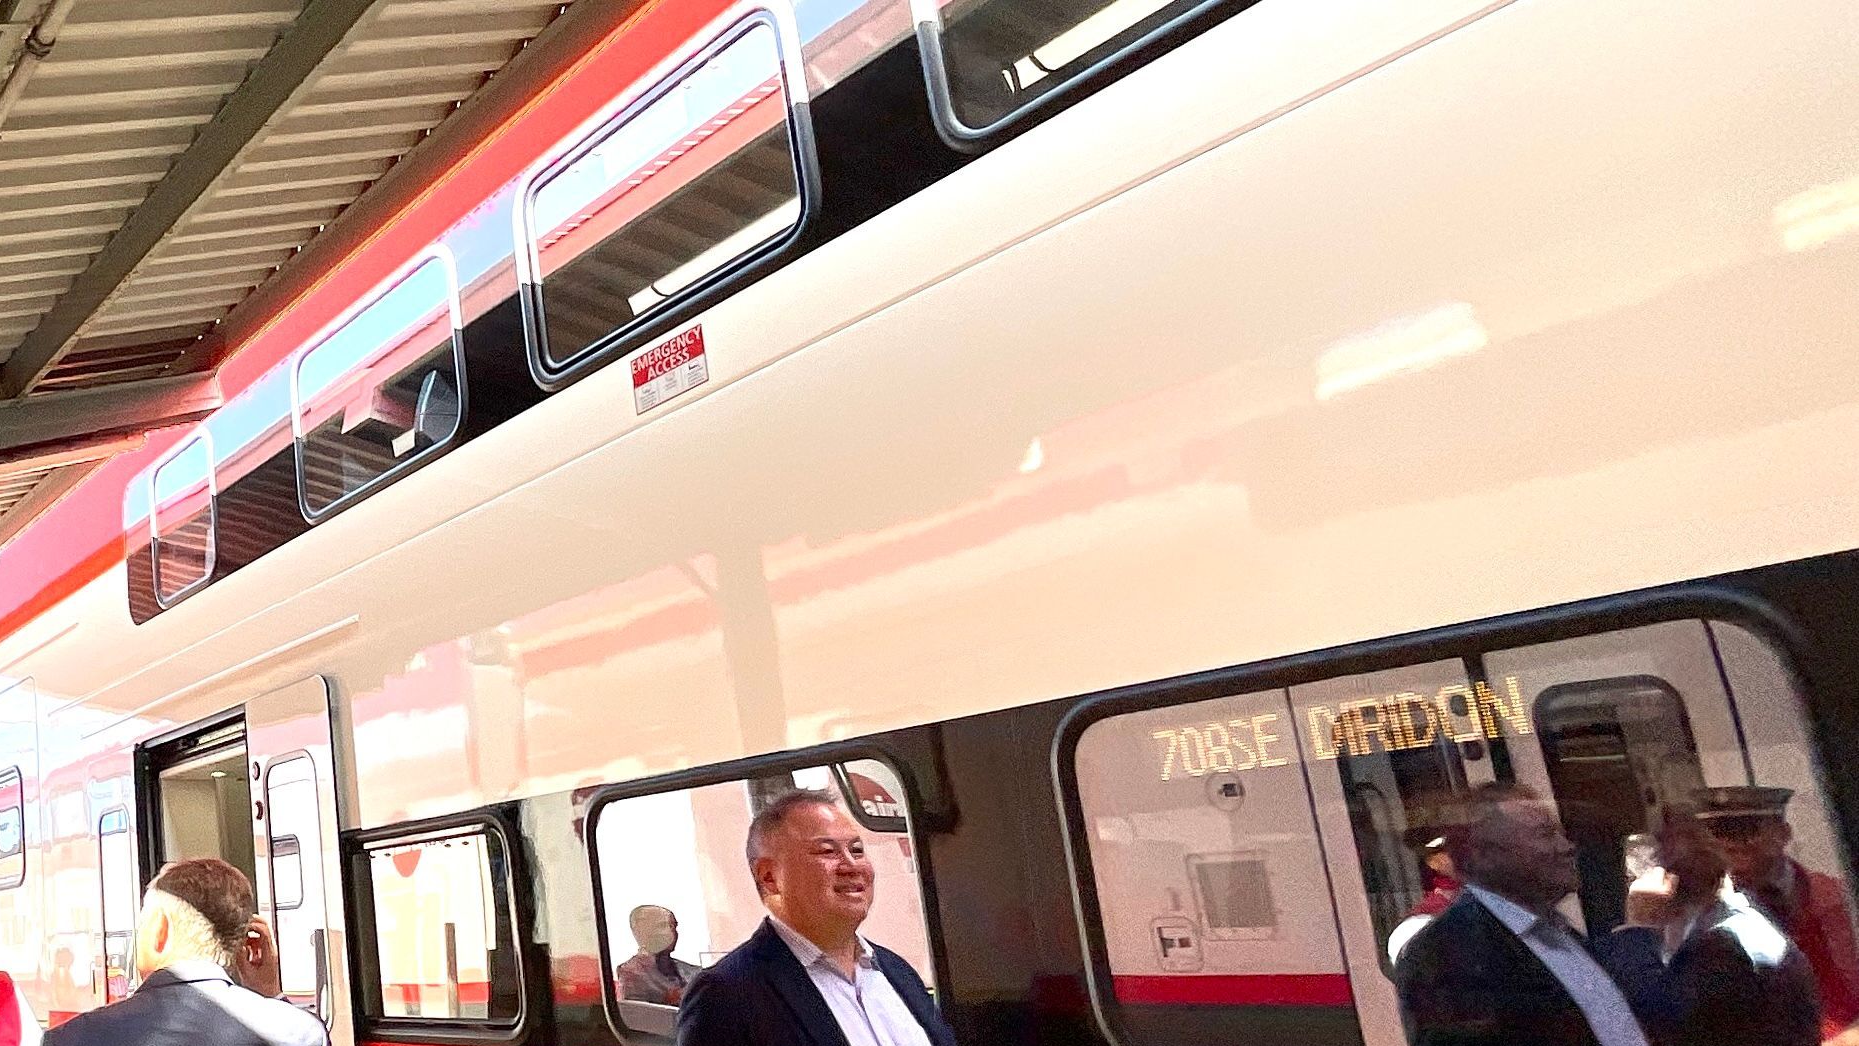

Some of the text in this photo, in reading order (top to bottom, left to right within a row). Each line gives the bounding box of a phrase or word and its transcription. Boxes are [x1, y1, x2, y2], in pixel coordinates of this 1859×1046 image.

[631, 325, 702, 374] EMERGENCY
[647, 347, 690, 381] ACCESS
[1308, 675, 1534, 760] DIRIDON
